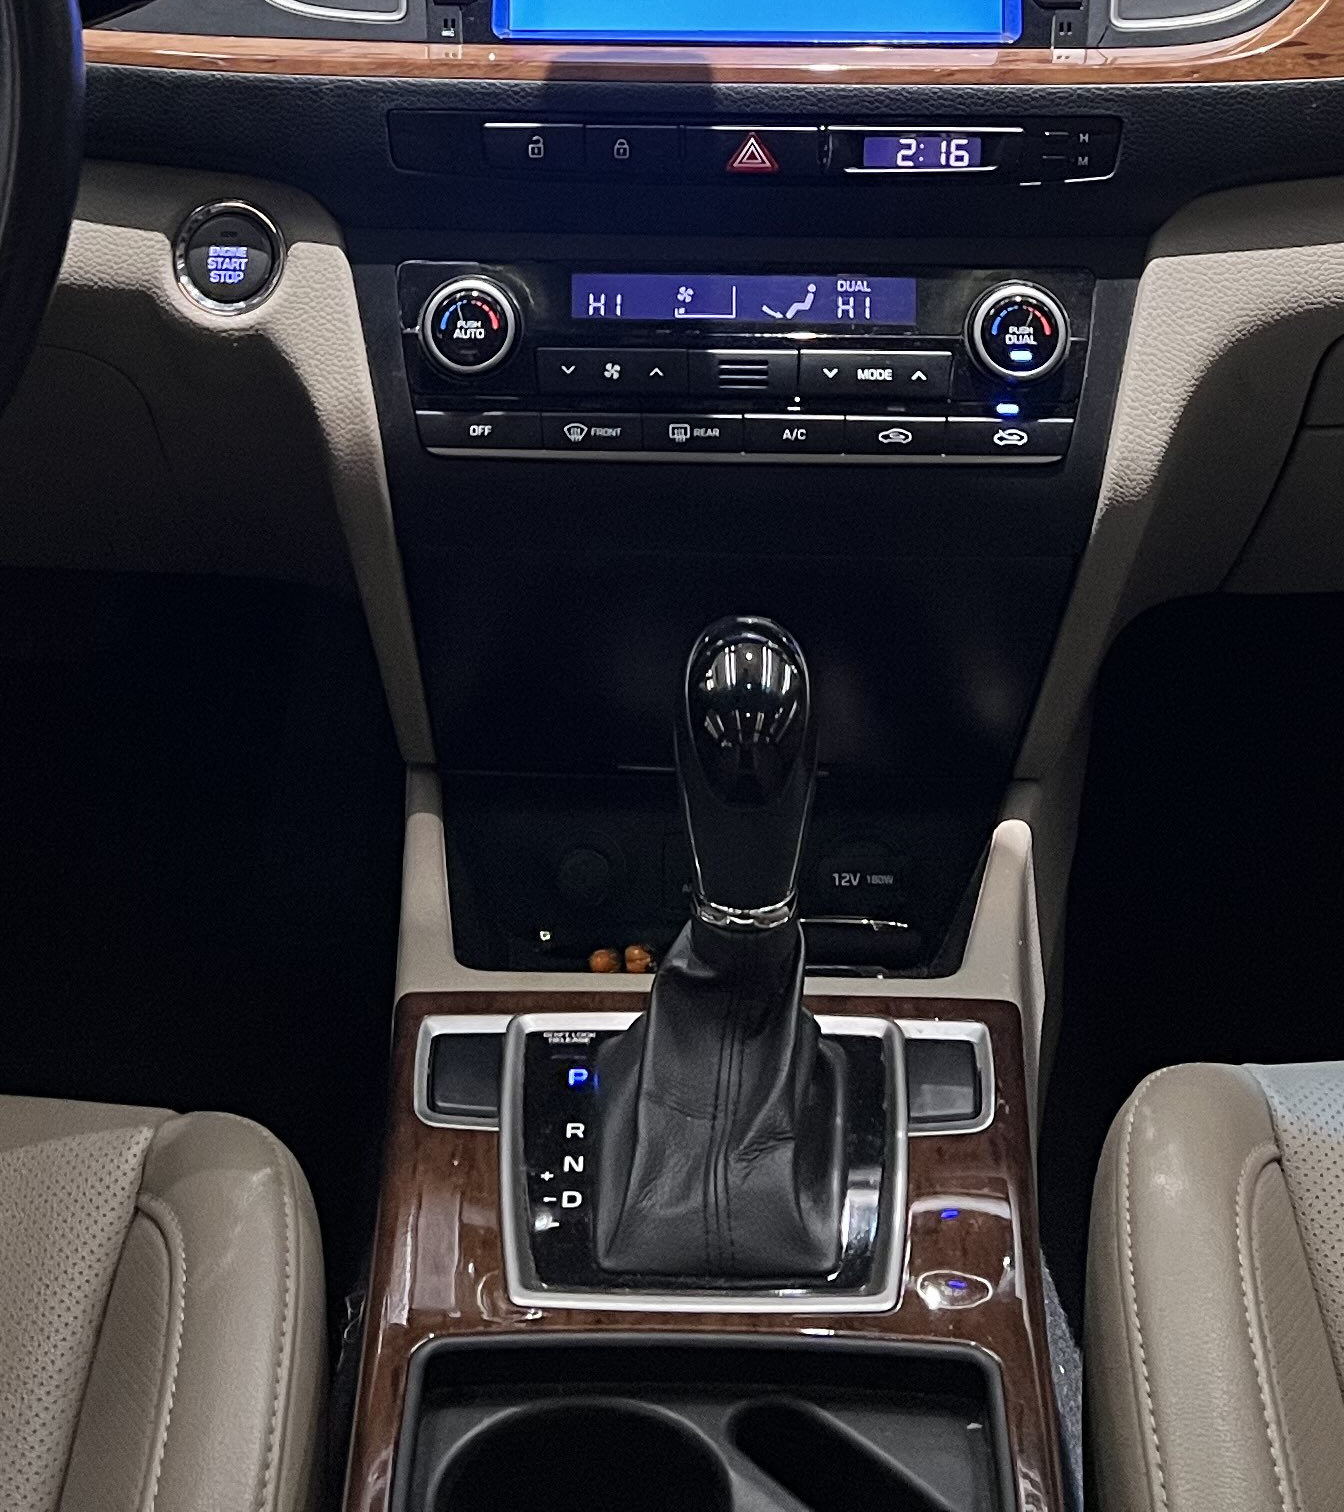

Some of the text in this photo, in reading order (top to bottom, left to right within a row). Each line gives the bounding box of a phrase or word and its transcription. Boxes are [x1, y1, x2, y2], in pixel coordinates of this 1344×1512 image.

[1079, 133, 1089, 143] H
[896, 138, 970, 166] 2:16
[1077, 156, 1089, 166] M
[208, 246, 248, 257] ENGINE
[207, 257, 249, 270] START
[209, 270, 244, 283] STOP
[836, 280, 871, 292] DUAL
[587, 292, 623, 317] HI
[836, 296, 871, 320] HI
[456, 320, 482, 329] PUSH
[1008, 326, 1034, 335] PUSH
[453, 328, 485, 339] AUTO
[1005, 334, 1038, 345] DUAL
[857, 368, 893, 381] MODE
[469, 424, 492, 436] OFF
[590, 426, 622, 437] FRONT
[693, 427, 720, 438] REAR
[782, 428, 807, 440] A/C
[832, 872, 861, 886] 12V
[568, 1068, 589, 1086] P
[565, 1122, 585, 1139] R
[563, 1155, 584, 1173] N
[561, 1190, 583, 1208] D
